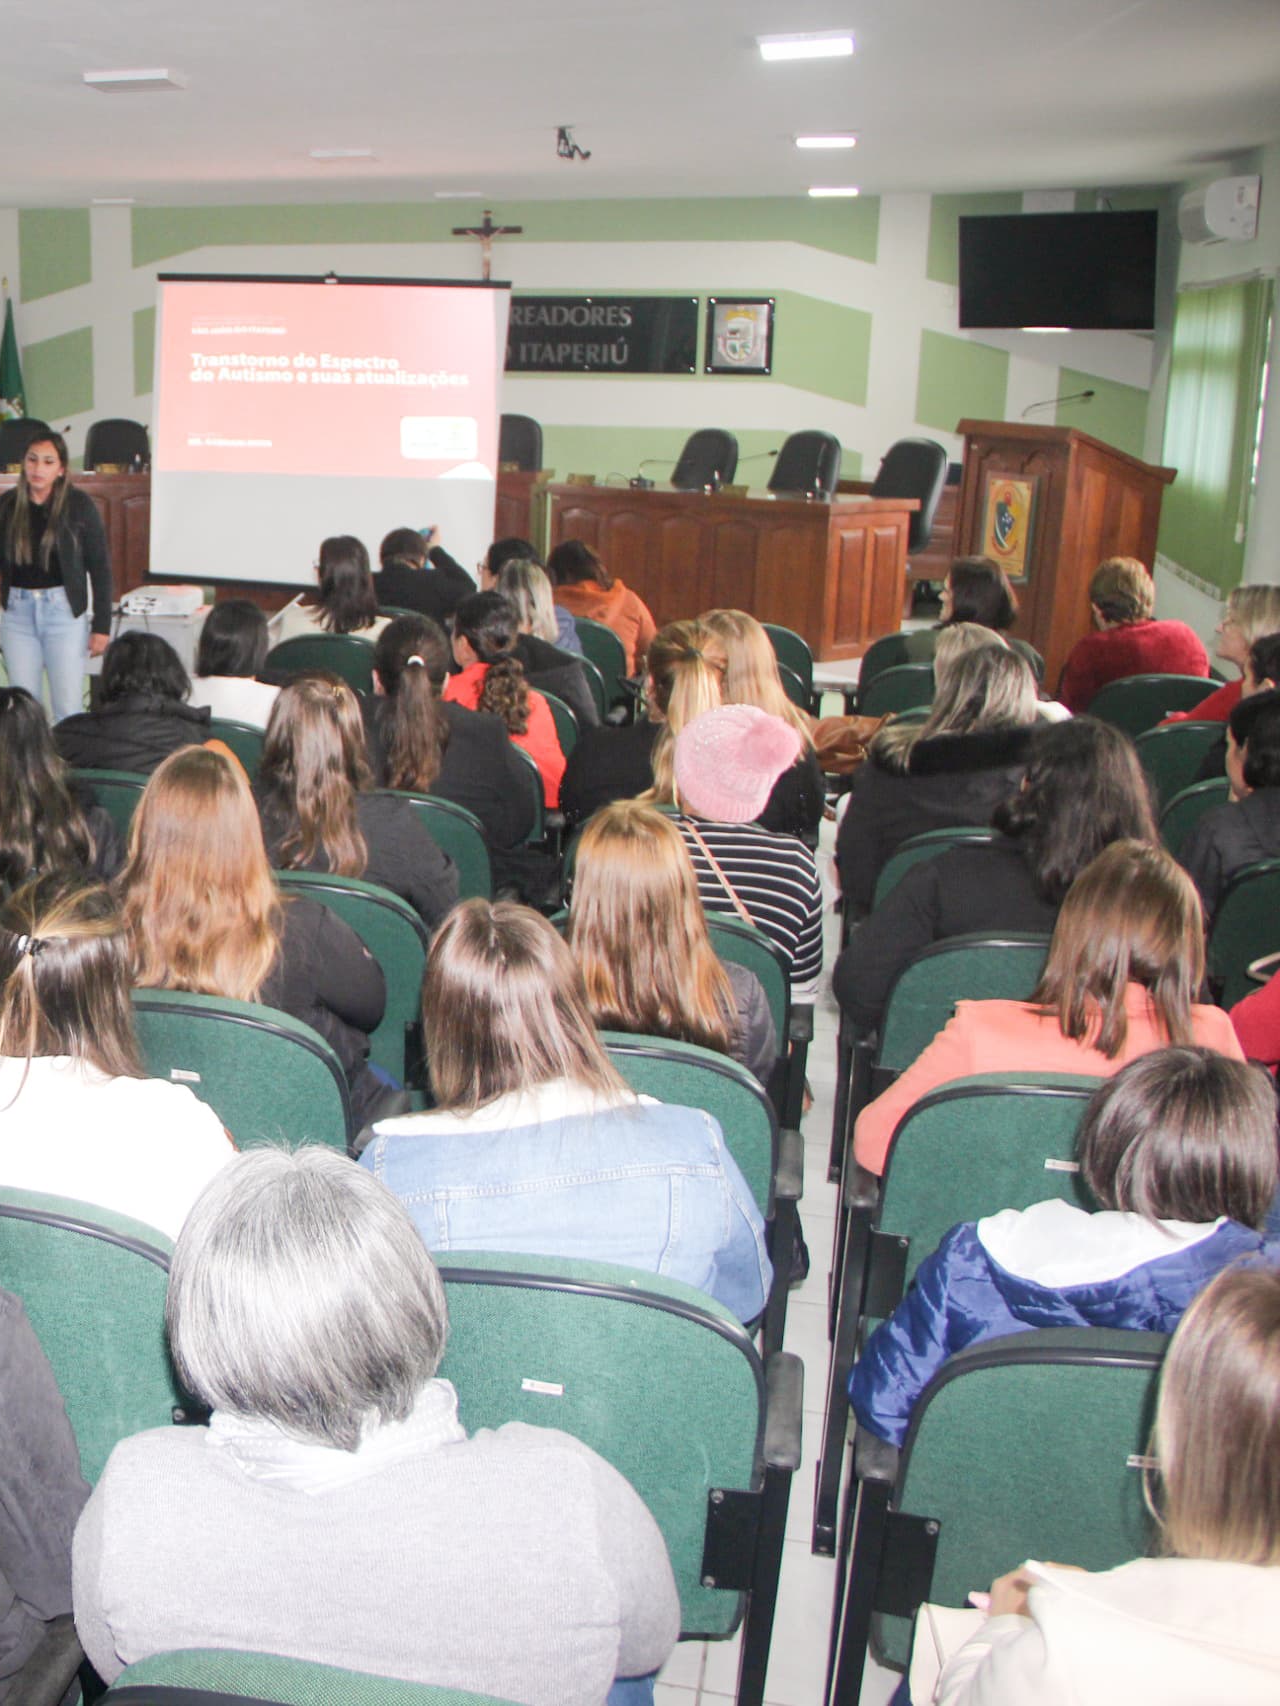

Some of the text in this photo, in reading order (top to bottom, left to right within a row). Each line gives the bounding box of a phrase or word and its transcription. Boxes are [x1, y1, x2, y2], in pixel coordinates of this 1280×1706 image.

[191, 352, 400, 371] Transtorno do Espectro
[520, 336, 628, 365] ITAPERIÚ
[189, 367, 470, 390] do Autismo e suas atualizações
